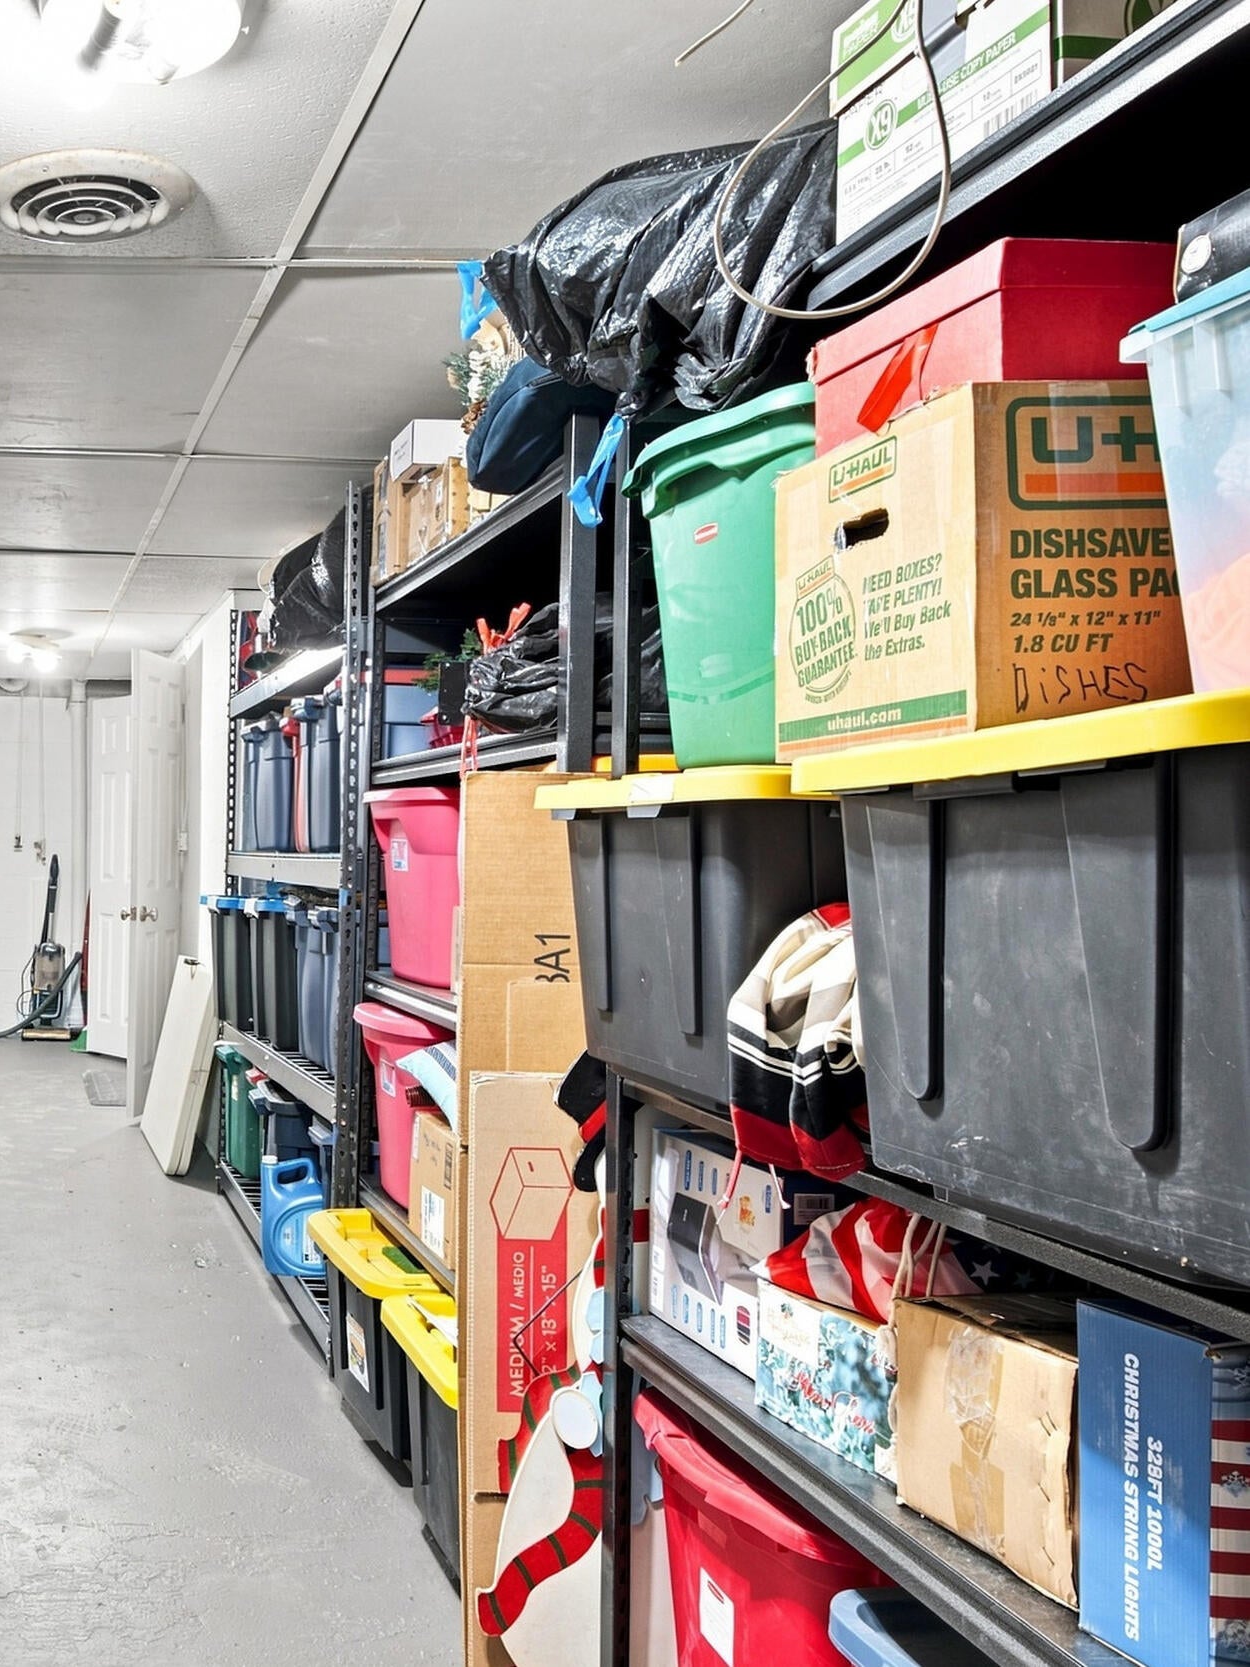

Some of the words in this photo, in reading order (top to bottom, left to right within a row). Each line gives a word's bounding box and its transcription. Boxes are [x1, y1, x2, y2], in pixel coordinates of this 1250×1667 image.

[960, 52, 986, 81] COPY
[986, 31, 1016, 65] PAPER
[868, 105, 892, 146] X9
[833, 446, 892, 486] U-HAUL
[1010, 527, 1176, 559] DISHSAVE
[896, 552, 942, 584] BOXES?
[1010, 567, 1118, 599] GLASS
[894, 577, 943, 608] PLENTY!
[796, 583, 843, 637] 100%
[894, 611, 916, 632] Buy
[920, 599, 952, 625] Back
[1010, 612, 1031, 627] 24
[1069, 614, 1080, 626] x
[1085, 611, 1114, 626] 12"
[1118, 613, 1129, 626] x
[1133, 610, 1161, 625] 11"
[885, 635, 925, 656] Extras.
[1013, 634, 1044, 653] 1.8
[1051, 634, 1080, 652] CU
[1085, 633, 1113, 652] FT
[827, 708, 902, 731] uhaul.com
[513, 1252, 525, 1298] MEDIO
[541, 1265, 557, 1291] 15"
[545, 1342, 556, 1351] x
[1124, 1352, 1140, 1479] CHRISTMAS
[1147, 1436, 1163, 1505] 328FT
[1124, 1479, 1140, 1561] STRING
[1147, 1504, 1163, 1572] 1000L
[1124, 1561, 1140, 1643] LIGHTS
